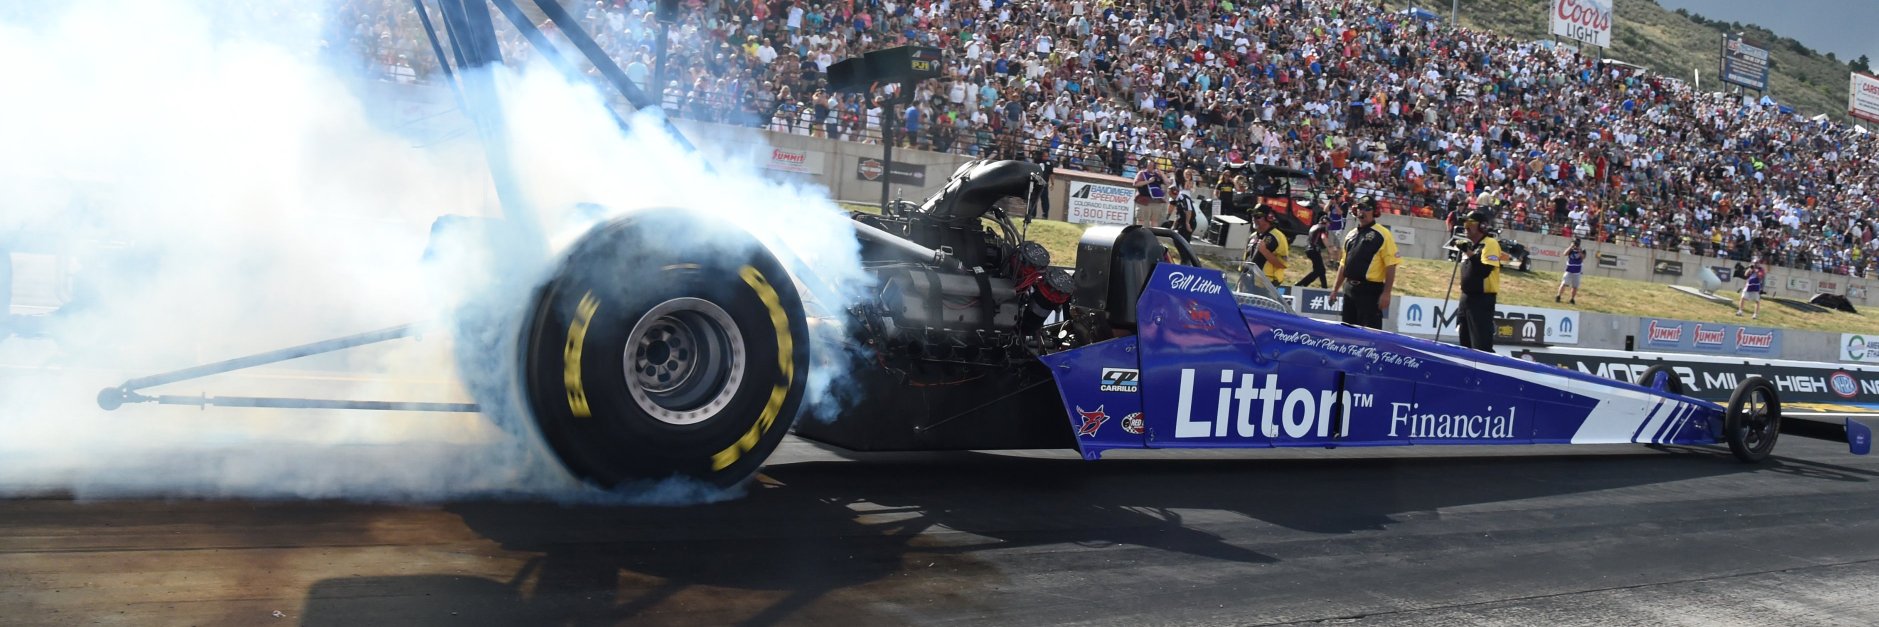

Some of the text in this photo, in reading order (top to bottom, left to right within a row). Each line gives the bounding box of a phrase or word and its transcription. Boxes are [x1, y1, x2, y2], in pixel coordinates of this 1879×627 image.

[1558, 0, 1609, 31] Coors
[1566, 22, 1600, 44] LIGHT
[1090, 185, 1133, 197] BANDIMERE
[1090, 192, 1131, 205] SPEEDWAY
[1073, 200, 1130, 212] COLORADO ELEVATION
[1073, 206, 1129, 222] 5,800 FEET
[1168, 271, 1222, 295] Bill Litton
[1648, 320, 1682, 344] SUMMIT
[1693, 324, 1725, 347] SUMMIT
[1735, 327, 1773, 350] SUMMIT
[1300, 333, 1322, 348] Don't
[1321, 338, 1339, 352] Plan
[1338, 344, 1347, 354] to
[1364, 347, 1380, 364] They
[1381, 351, 1398, 364] Fail
[1394, 356, 1403, 365] to
[1576, 361, 1701, 392] MOPR
[1175, 368, 1351, 438] Litton
[1387, 402, 1516, 438] Financial
